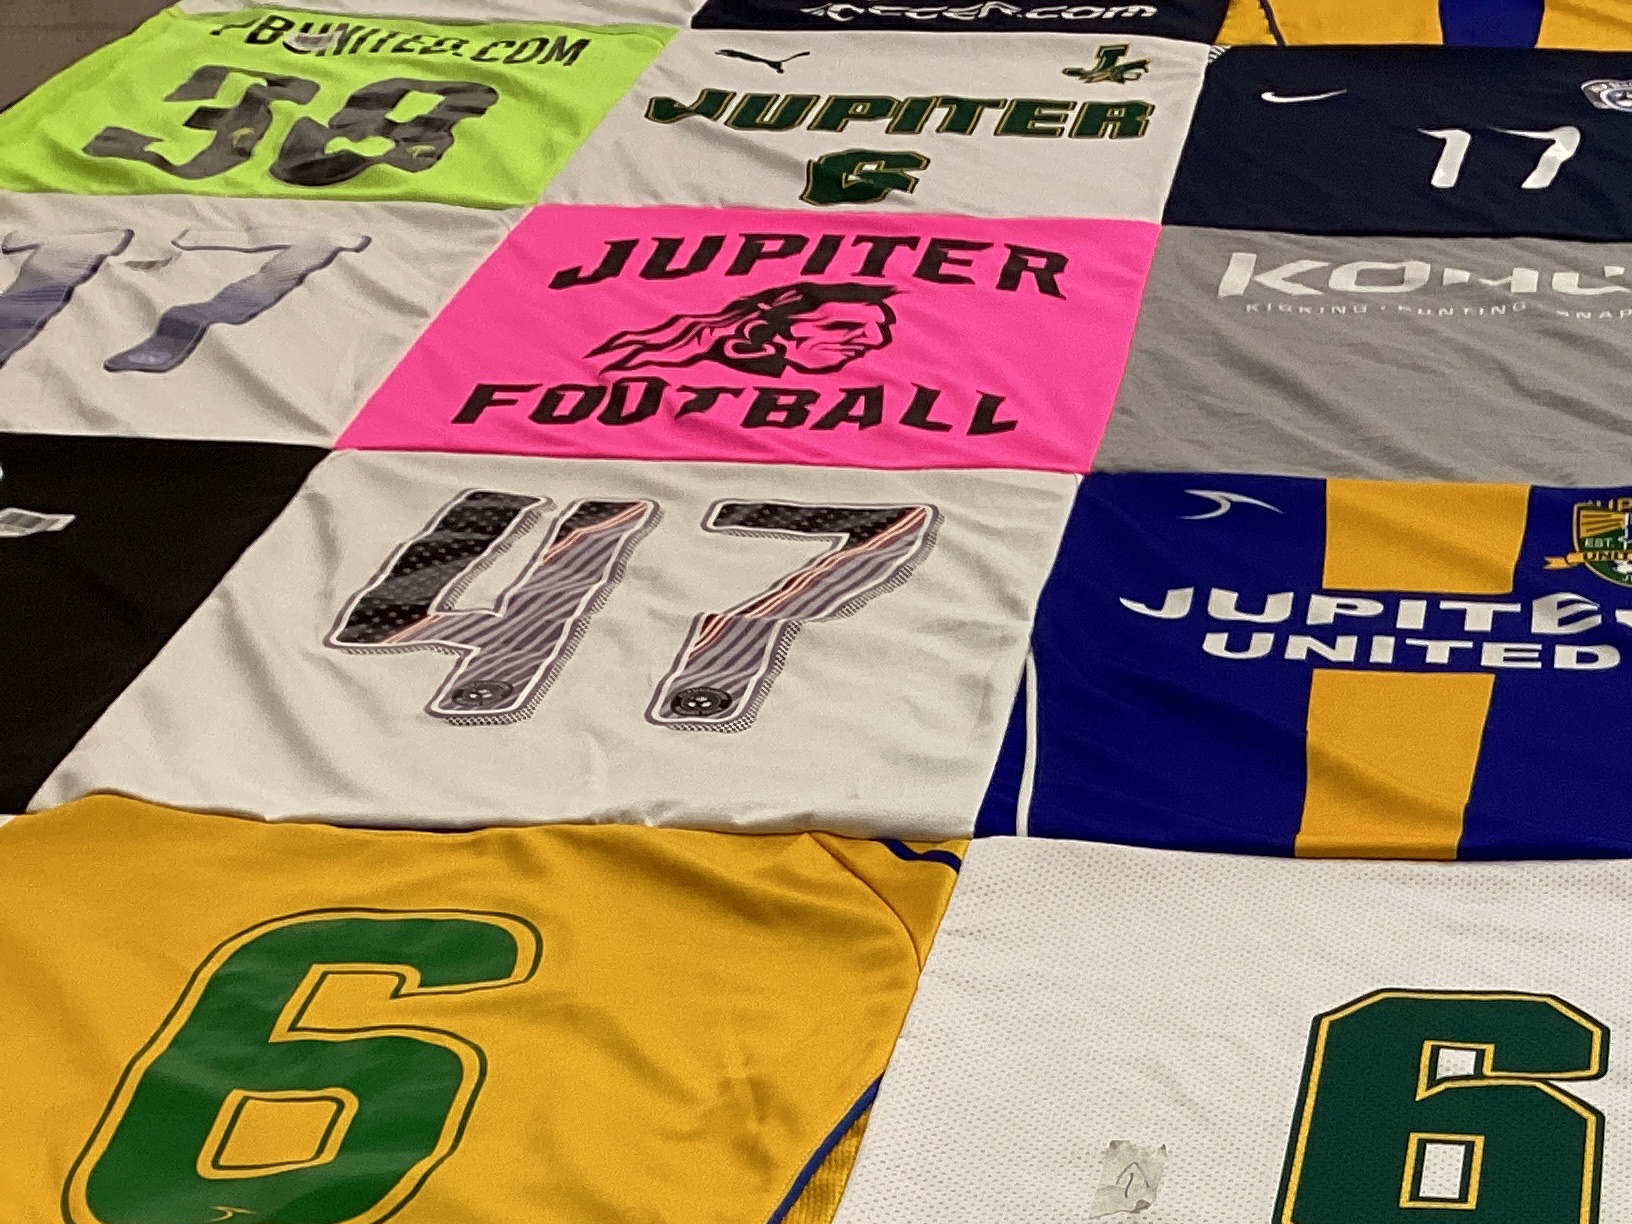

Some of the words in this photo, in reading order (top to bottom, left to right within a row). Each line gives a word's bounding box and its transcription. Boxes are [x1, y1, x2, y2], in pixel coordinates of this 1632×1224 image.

[82, 64, 500, 187] 38
[645, 88, 1156, 140] JUPITER
[799, 148, 931, 206] 6
[1416, 125, 1581, 190] 17
[548, 233, 1069, 300] JUPITER
[451, 376, 1018, 437] FOOTBALL
[324, 488, 945, 732] 47
[1202, 632, 1621, 671] UNITED
